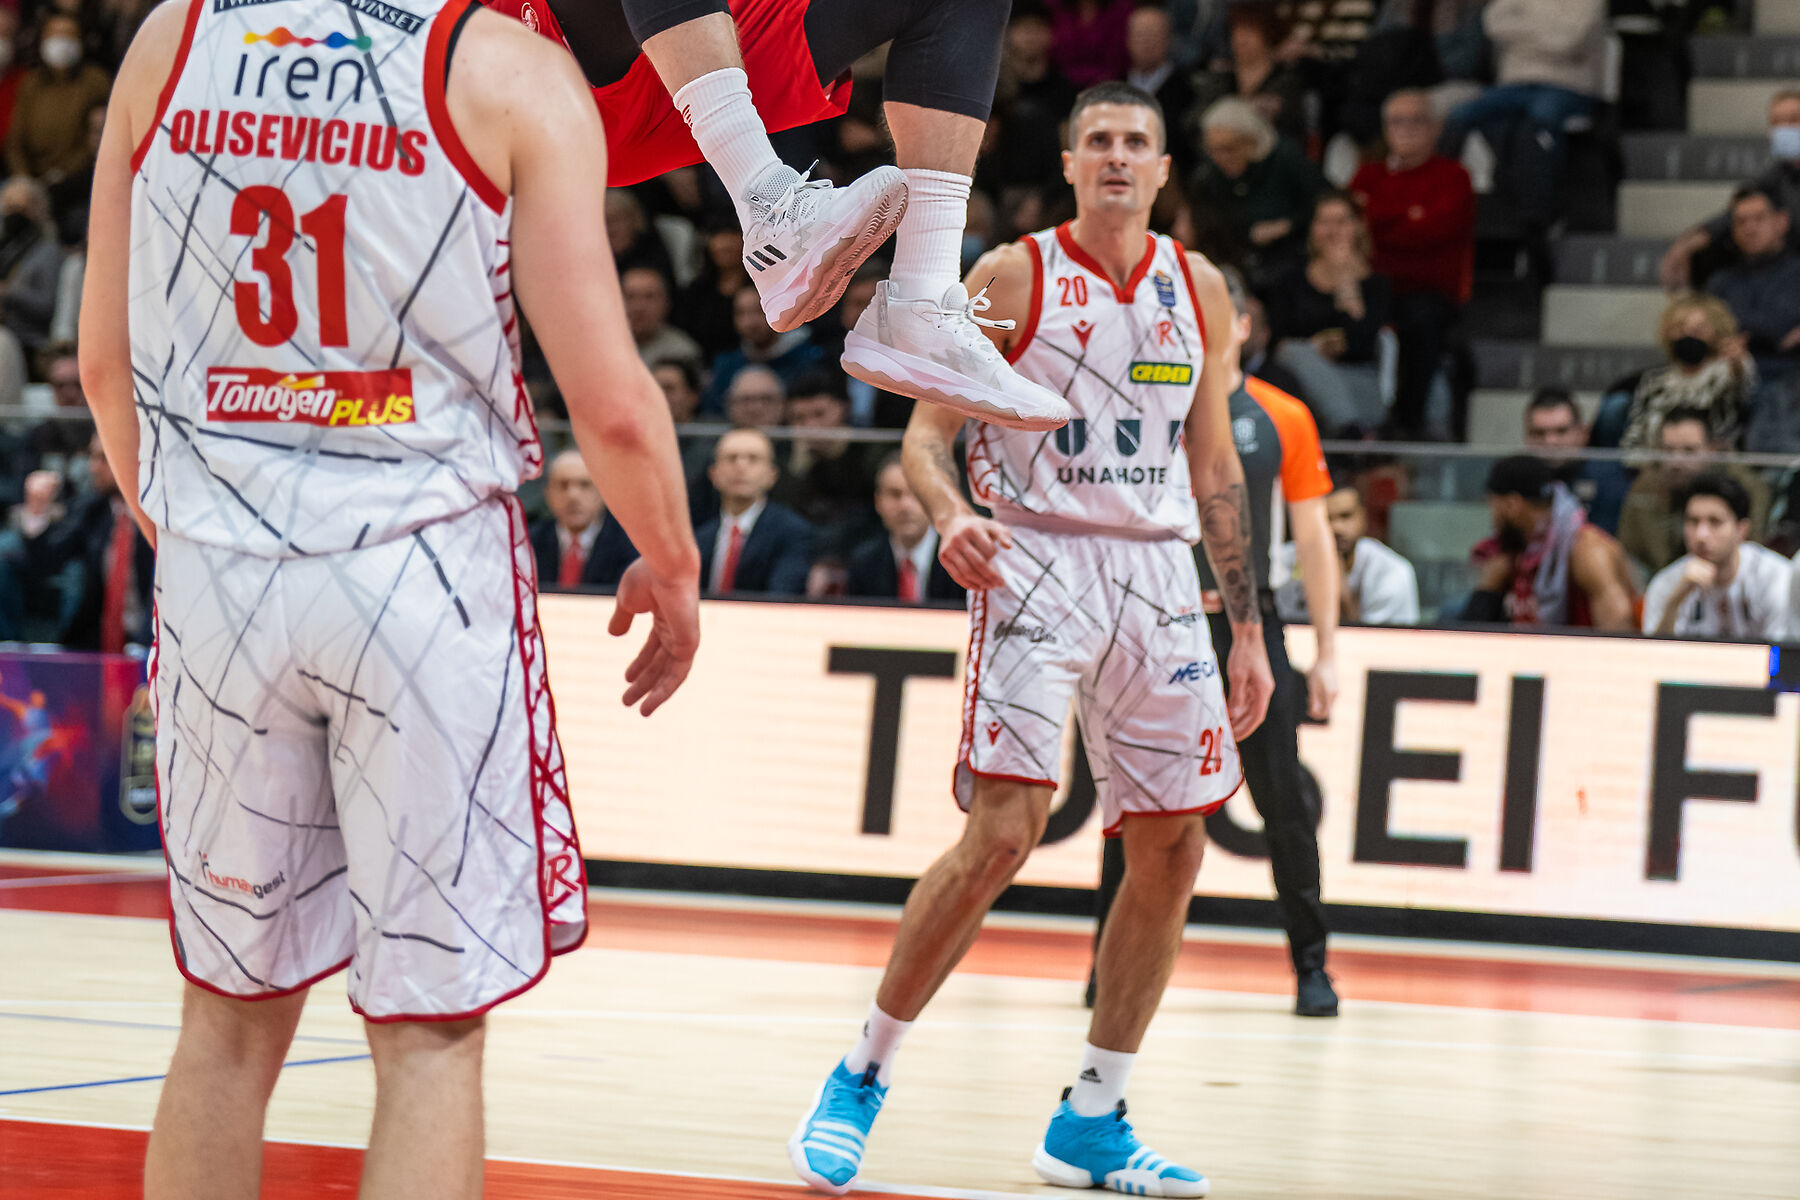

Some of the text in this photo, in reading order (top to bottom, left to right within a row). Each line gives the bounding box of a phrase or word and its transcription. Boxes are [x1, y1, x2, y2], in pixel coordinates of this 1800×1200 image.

[169, 108, 428, 177] OLISEVICIUS
[229, 184, 349, 348] 31
[1057, 275, 1088, 307] 20
[207, 374, 413, 427] Tonogen PLUS
